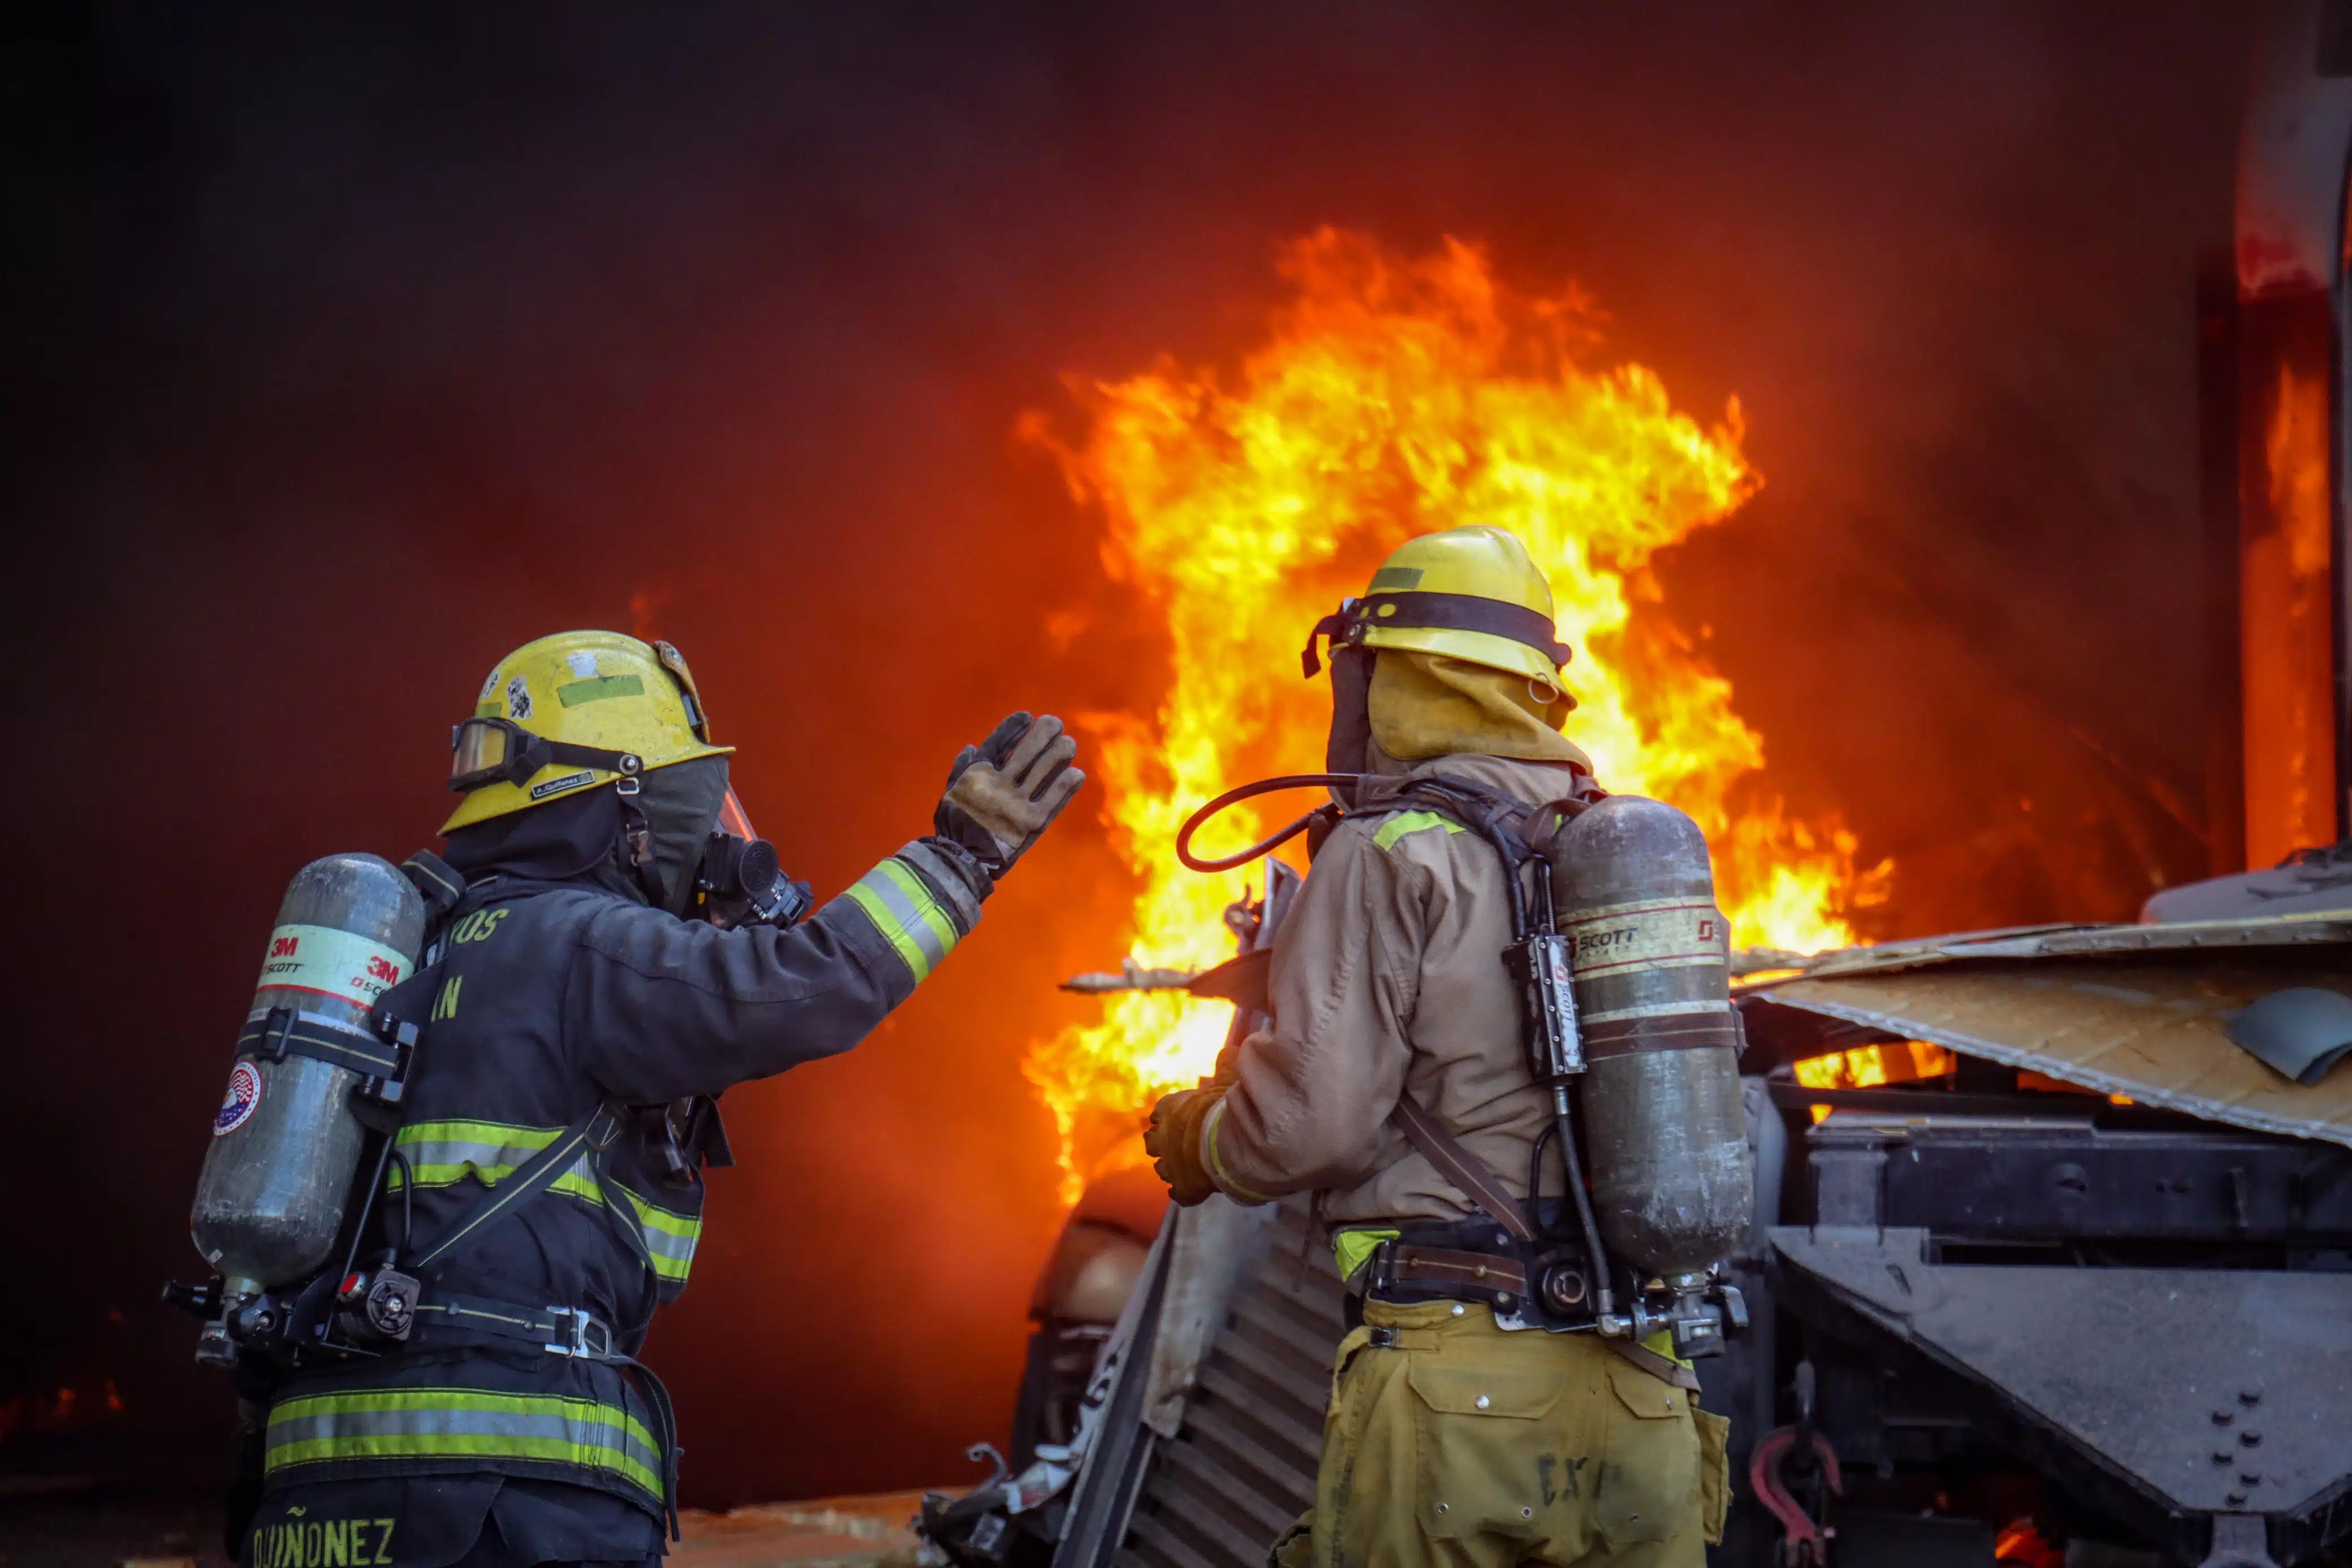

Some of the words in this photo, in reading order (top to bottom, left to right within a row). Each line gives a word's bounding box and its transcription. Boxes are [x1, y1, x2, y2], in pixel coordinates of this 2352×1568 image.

[271, 937, 299, 958] 3M
[1580, 927, 1638, 952] SCOTT
[367, 956, 400, 986] 3M
